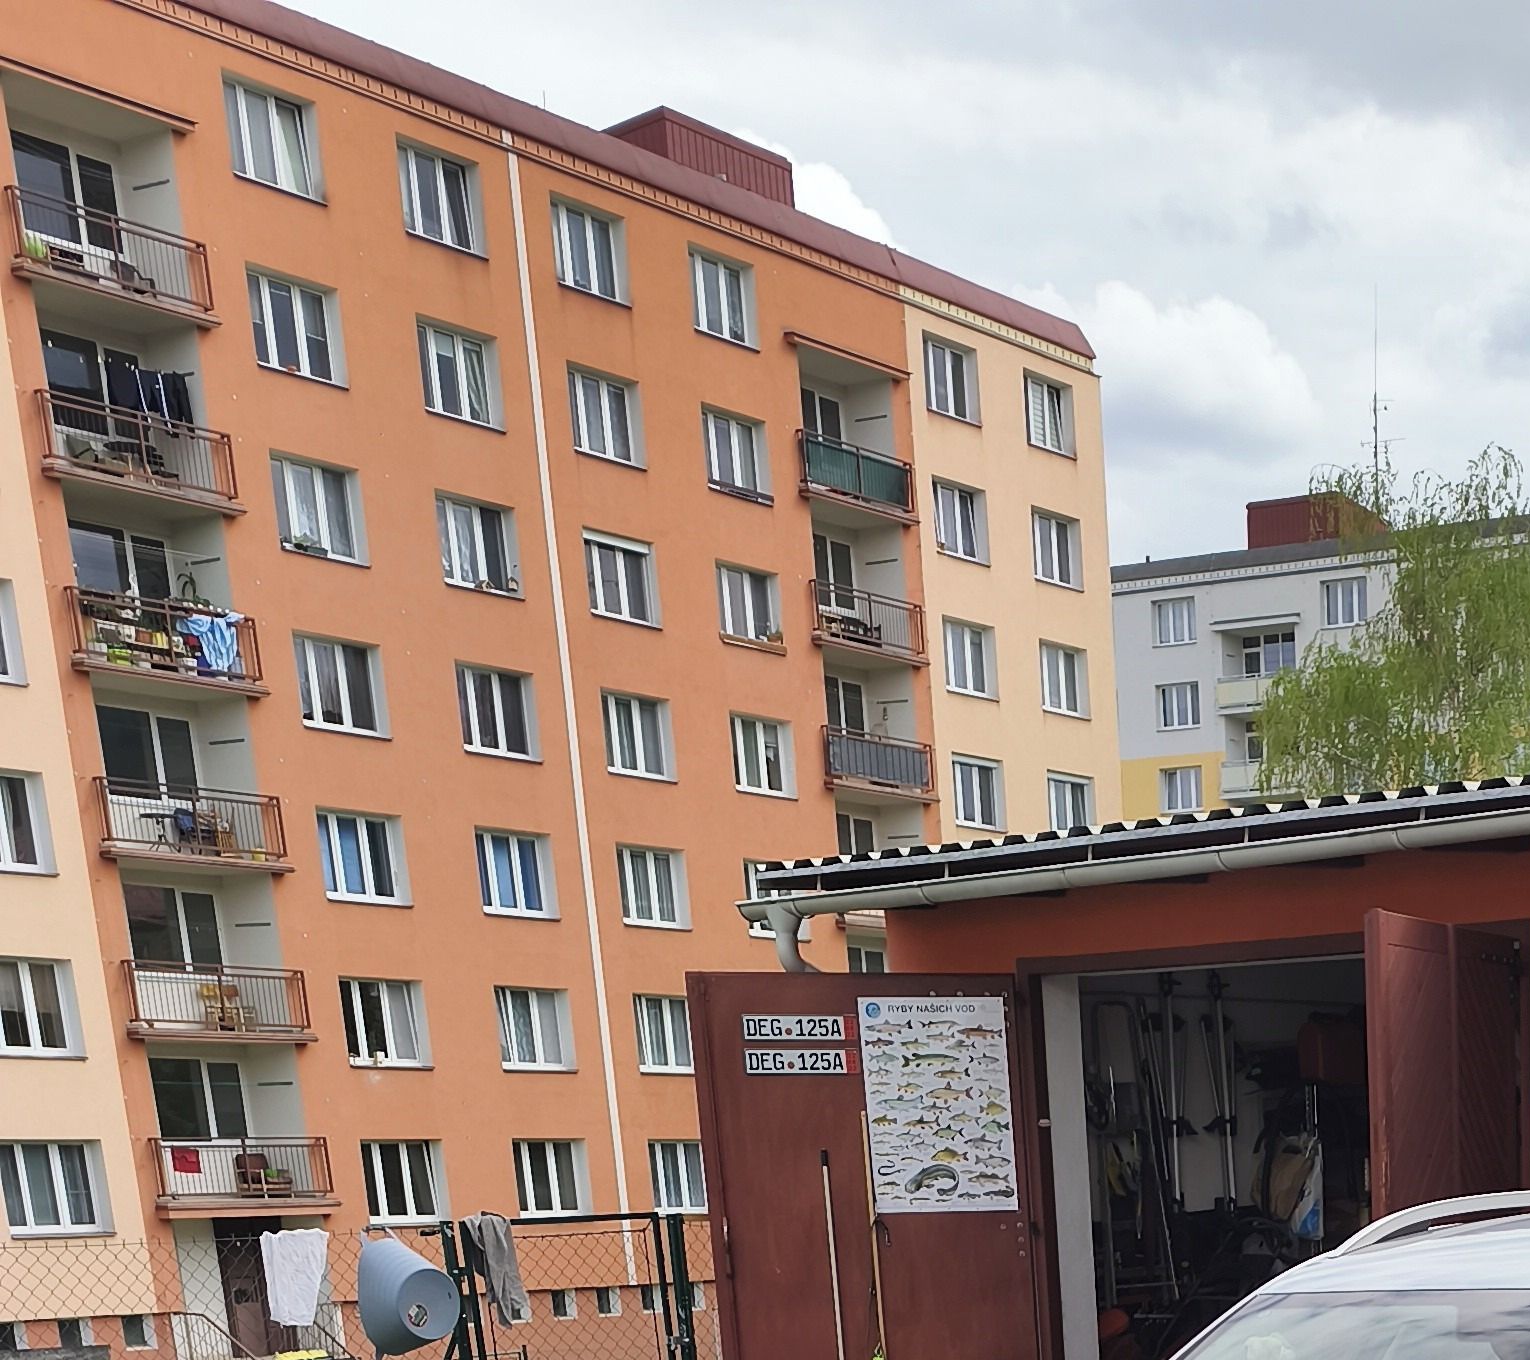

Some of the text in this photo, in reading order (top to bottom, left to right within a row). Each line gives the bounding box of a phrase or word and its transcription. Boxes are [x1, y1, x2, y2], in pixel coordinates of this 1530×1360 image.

[887, 1004, 914, 1013] RYBY
[955, 1004, 976, 1013] VOD
[745, 1018, 783, 1037] DEG
[795, 1018, 842, 1037] 125A
[747, 1052, 785, 1071] DEG
[797, 1052, 844, 1071] 125A
